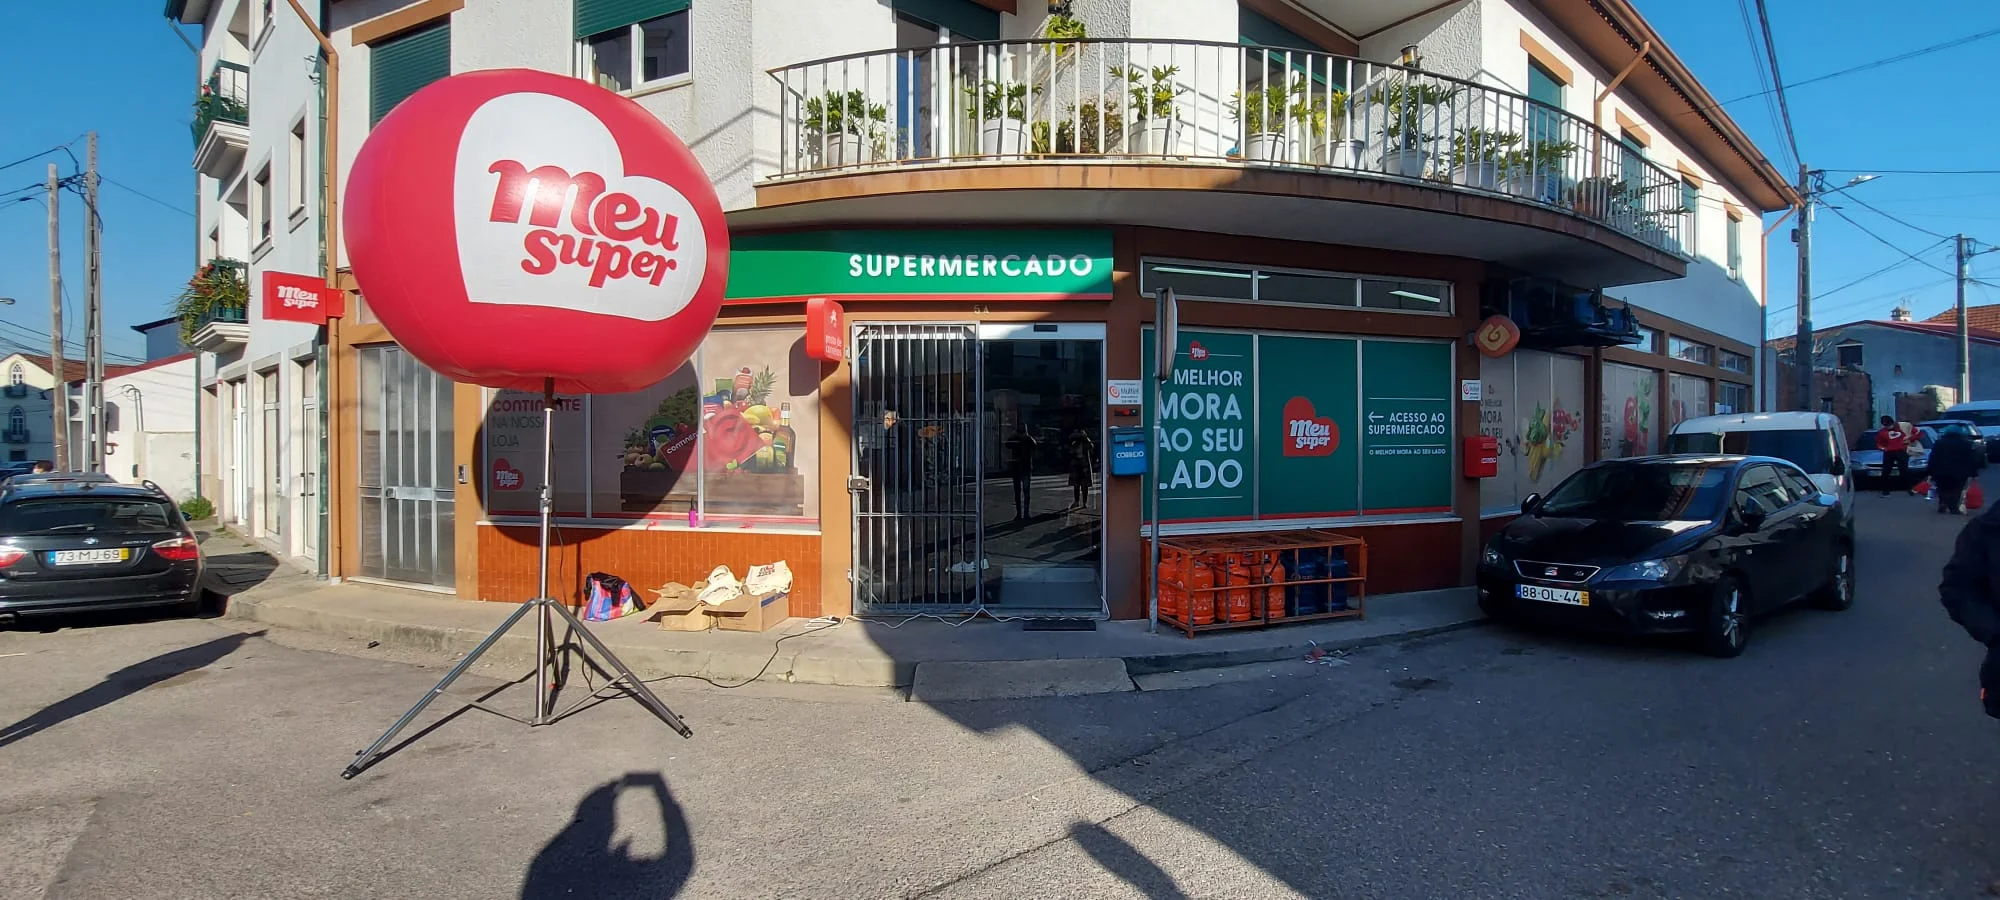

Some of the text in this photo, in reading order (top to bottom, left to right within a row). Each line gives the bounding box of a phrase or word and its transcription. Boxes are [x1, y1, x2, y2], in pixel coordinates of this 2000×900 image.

[520, 229, 677, 289] super
[849, 253, 1093, 278] SUPERMERCADO
[283, 298, 319, 309] super
[1174, 369, 1243, 386] MELHOR
[493, 399, 581, 412] CONTINTE
[1158, 390, 1242, 420] MORA
[492, 415, 545, 429] NA NOSS
[1389, 412, 1445, 423] ACESSO AO
[1368, 424, 1446, 435] SUPERMERCADO
[492, 434, 519, 447] LOJA
[1159, 428, 1244, 452] AO SEU
[1295, 436, 1331, 449] super
